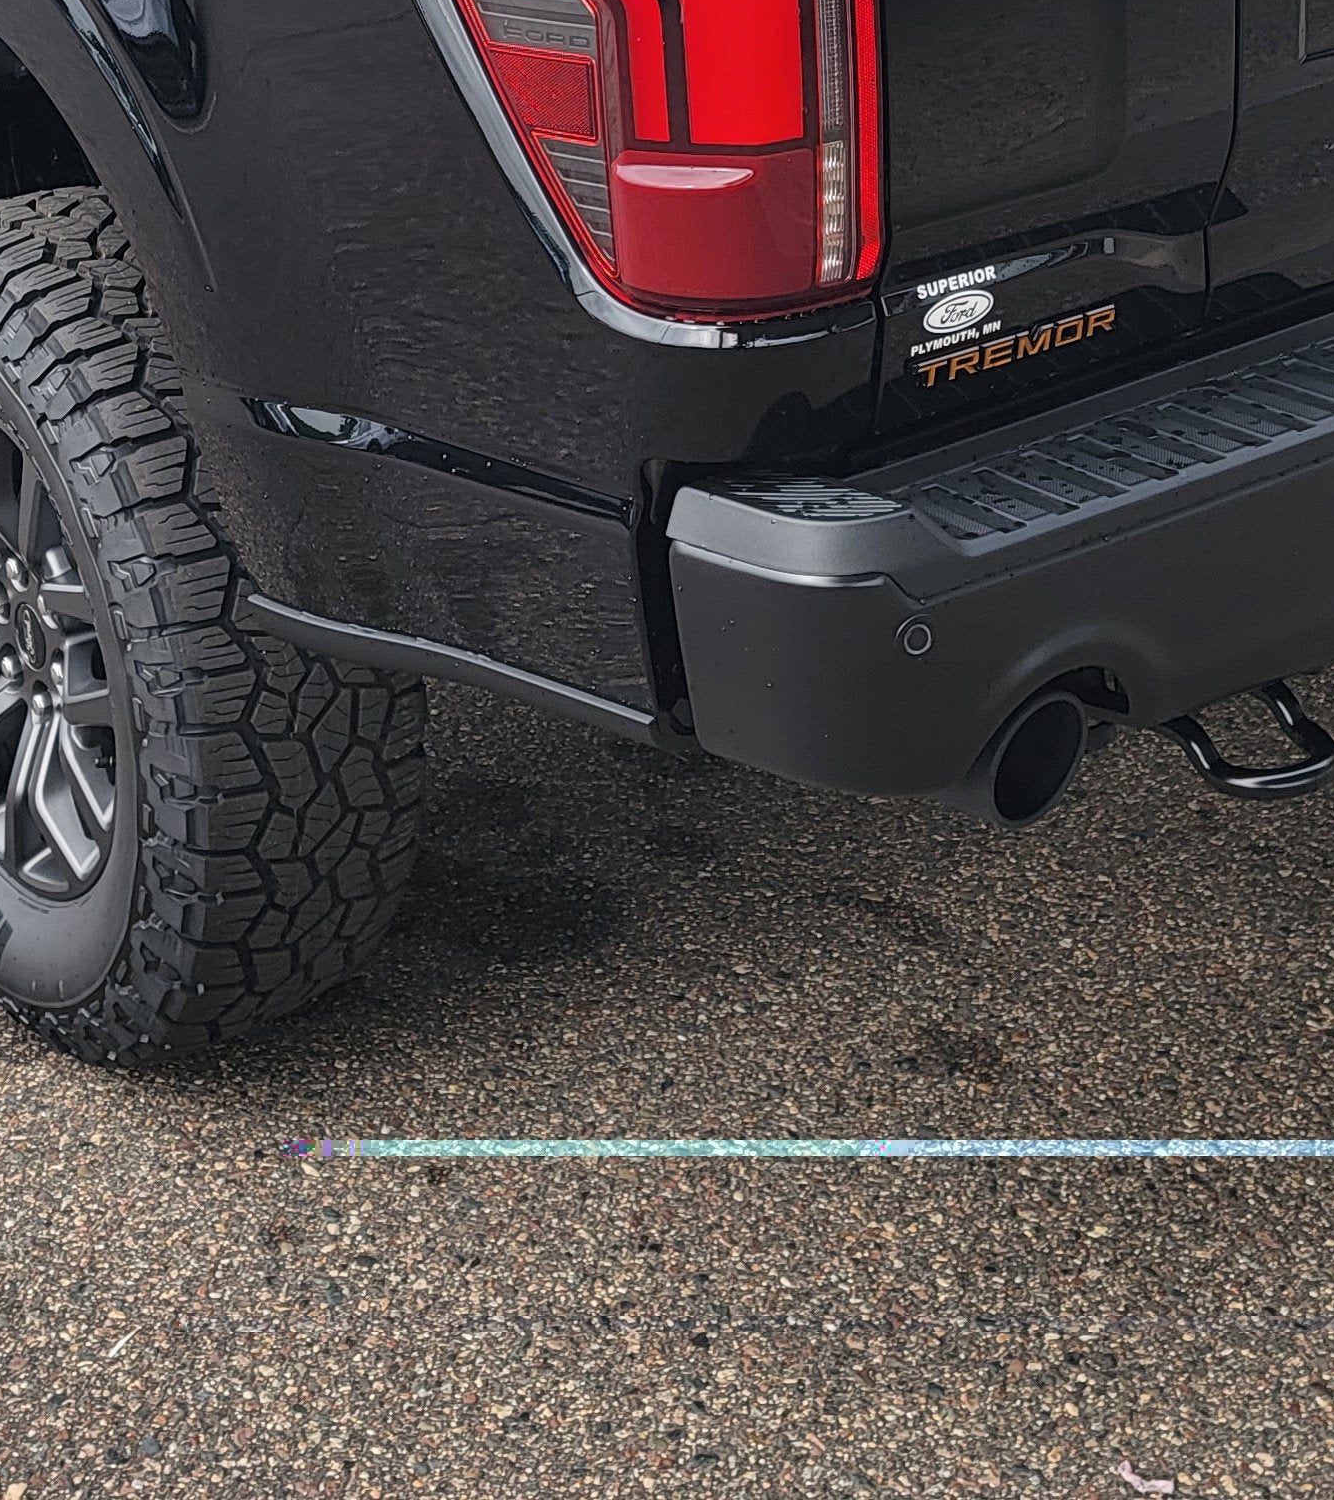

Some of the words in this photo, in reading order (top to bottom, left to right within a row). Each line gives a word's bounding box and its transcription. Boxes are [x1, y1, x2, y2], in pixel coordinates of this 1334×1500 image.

[916, 265, 997, 300] SUPERIOR
[940, 300, 977, 324] Ford
[910, 330, 980, 357] PLYMOUTH,
[982, 320, 1002, 335] MN
[917, 303, 1116, 388] TREMOR
